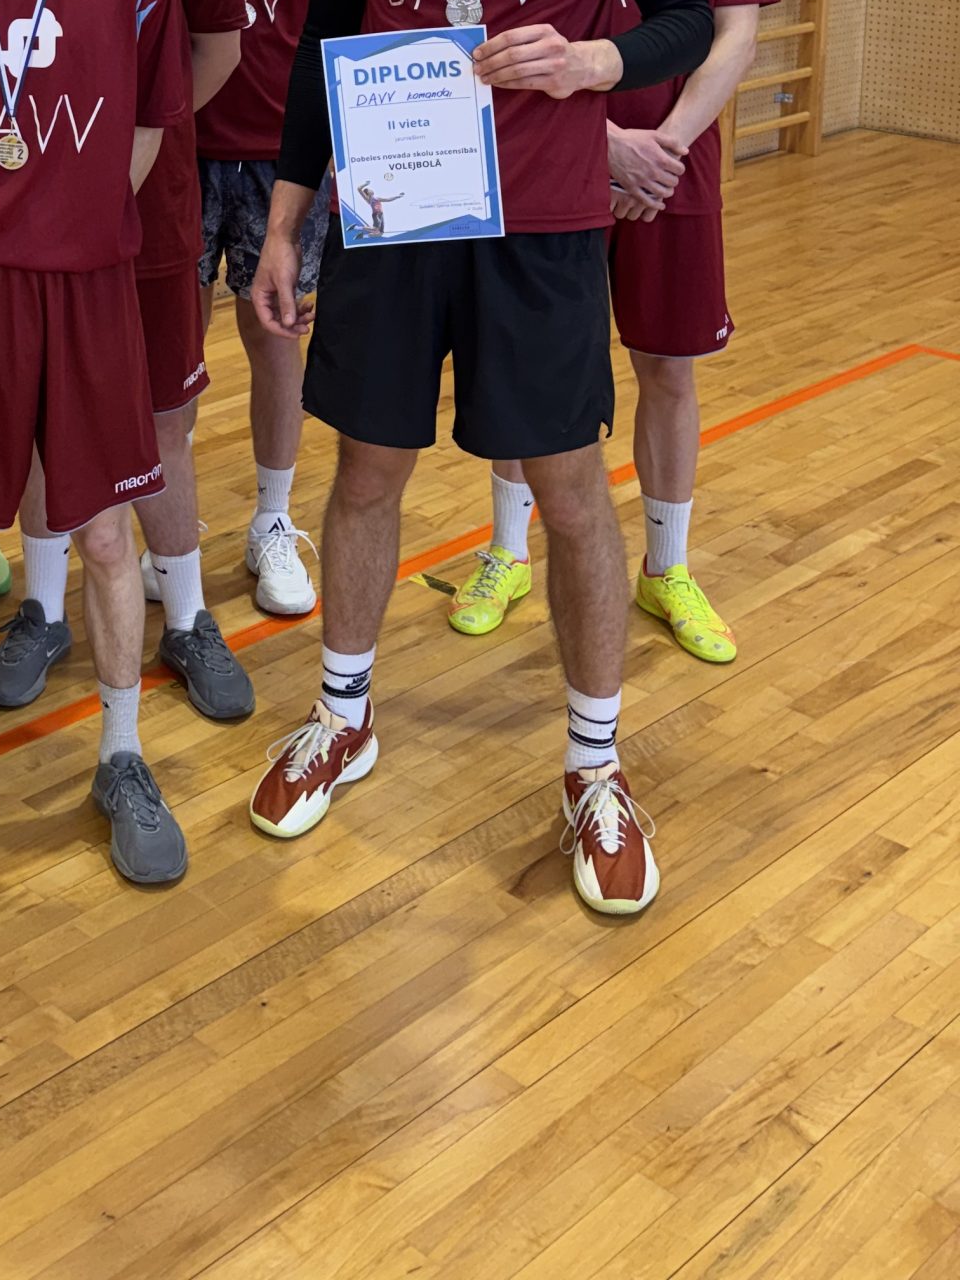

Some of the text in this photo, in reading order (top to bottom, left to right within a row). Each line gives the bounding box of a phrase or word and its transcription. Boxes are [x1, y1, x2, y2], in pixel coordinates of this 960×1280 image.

[353, 60, 462, 86] DIPLOMS
[356, 90, 396, 107] DAVV
[399, 119, 430, 129] vieta
[16, 148, 24, 160] 2
[350, 154, 381, 163] Dobeles
[382, 150, 411, 160] novada
[412, 149, 434, 158] skolu
[388, 159, 442, 171] VOLEJBOLĀ
[114, 463, 162, 494] macron
